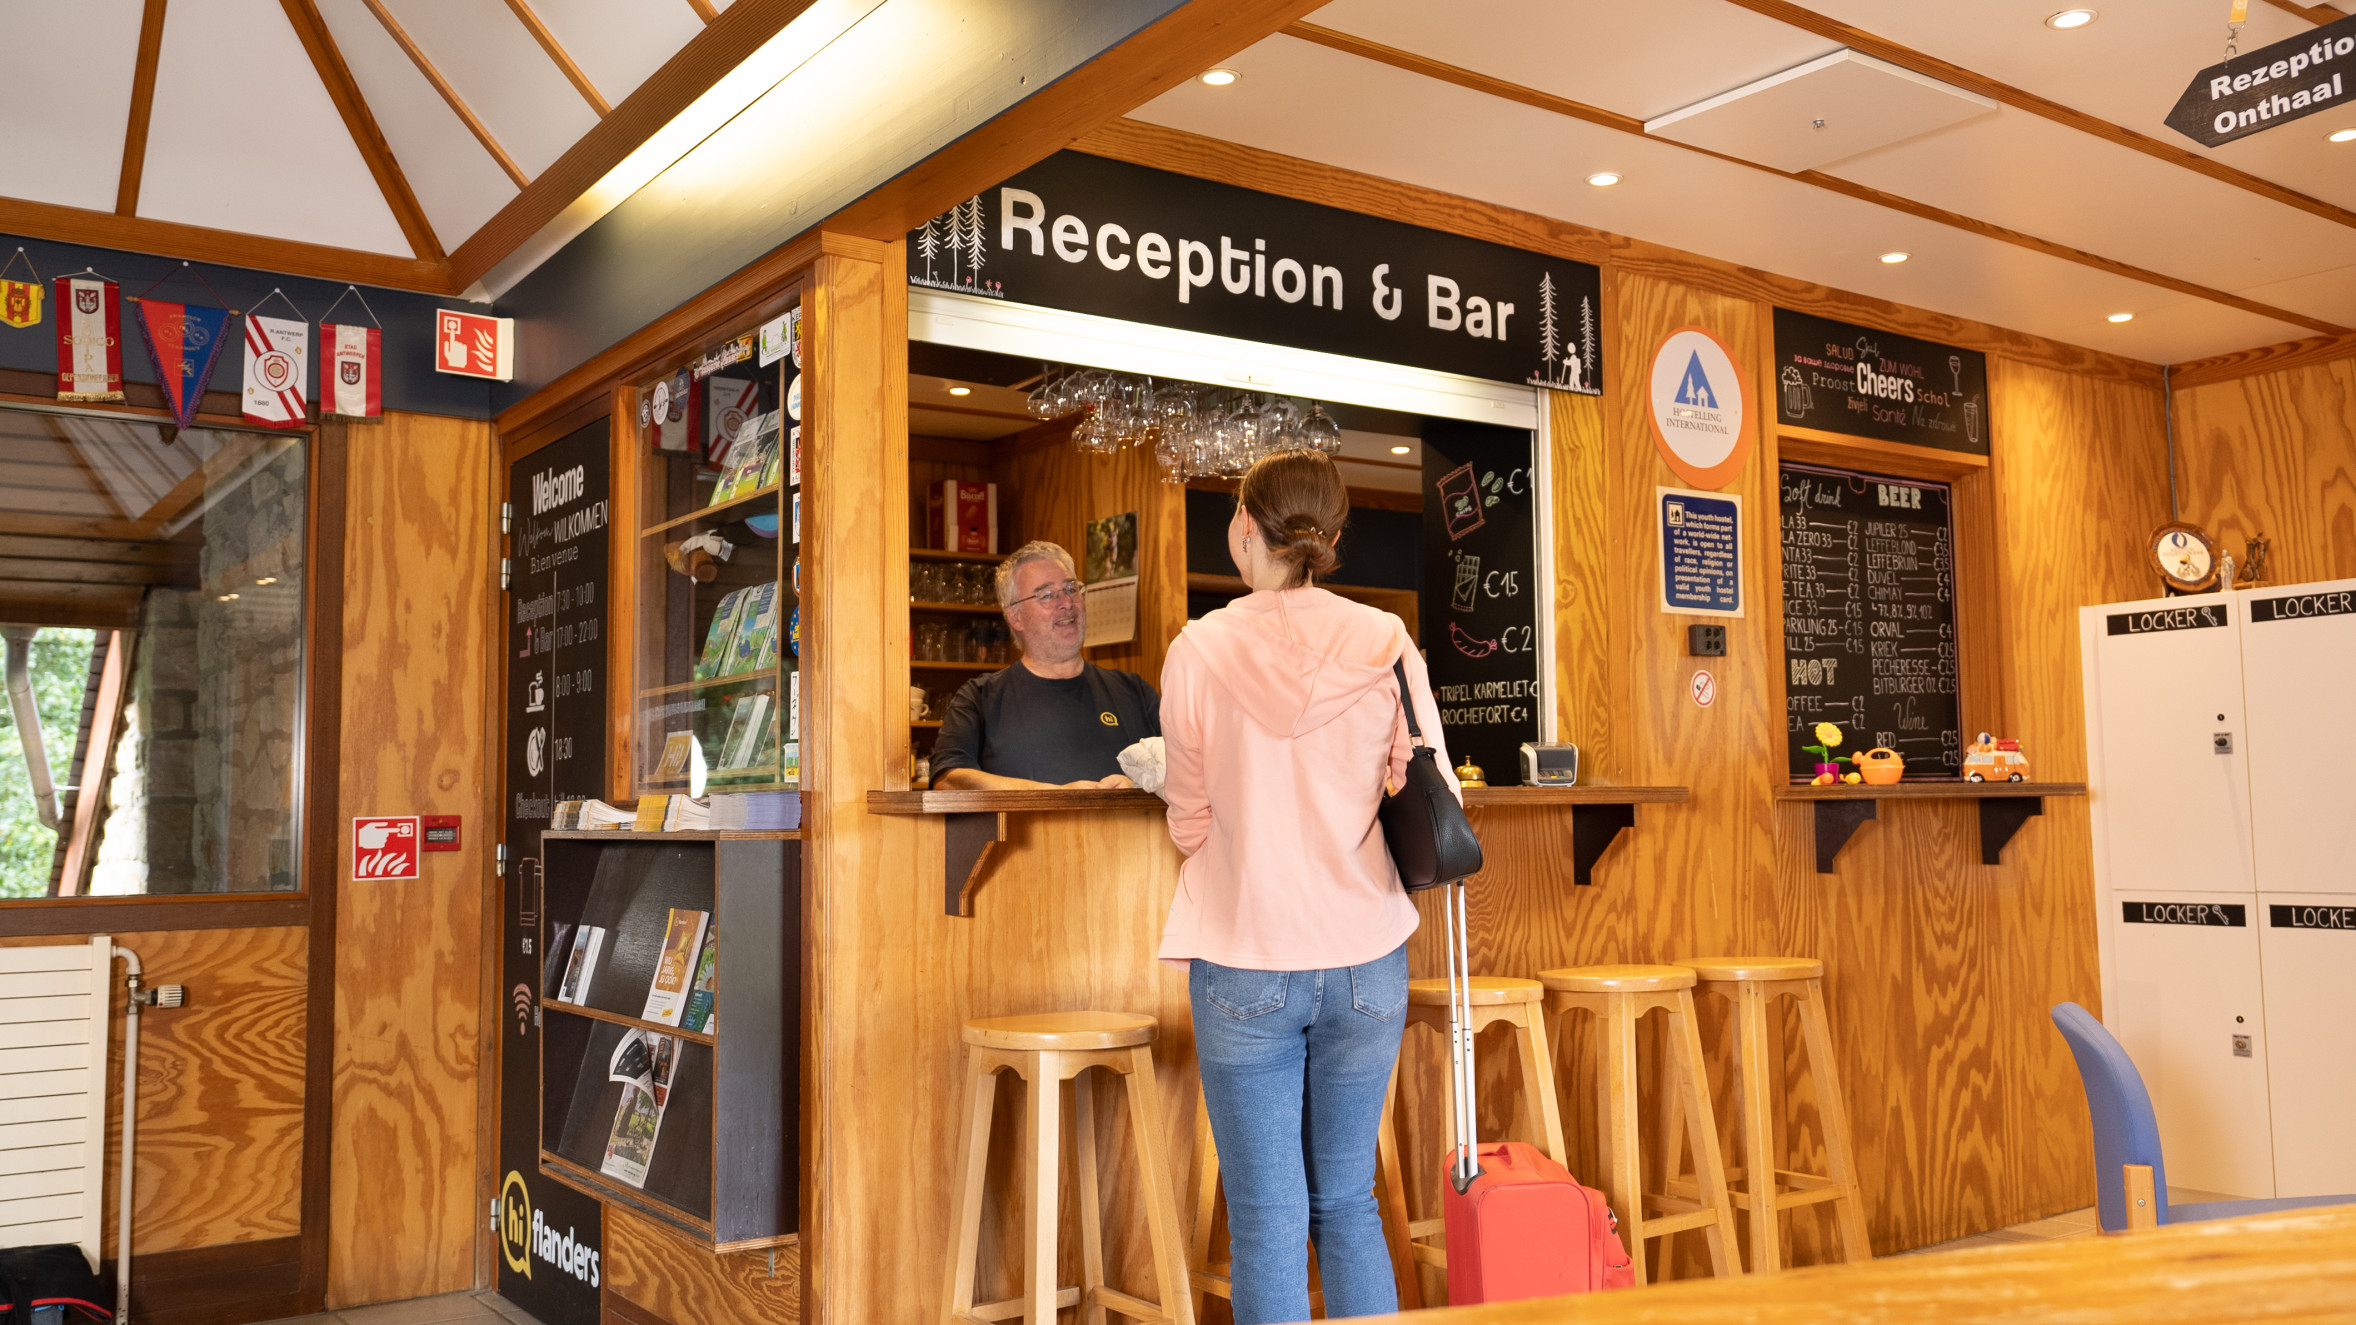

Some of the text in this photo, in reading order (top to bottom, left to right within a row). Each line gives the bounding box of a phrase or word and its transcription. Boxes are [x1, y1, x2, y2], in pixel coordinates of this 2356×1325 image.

[2210, 36, 2356, 100] Rezeptio
[2213, 73, 2343, 134] Onthaal
[1001, 187, 1514, 341] Reception & Bar
[1825, 343, 1854, 360] SALUD
[1880, 358, 1925, 379] ZUM WOHL
[1812, 372, 1857, 393] Proost
[1857, 361, 1914, 403] Cheers
[1917, 388, 1950, 408] Schol
[1872, 405, 1907, 426] Santé
[1666, 418, 1729, 435] INTERNATIONAL
[533, 464, 584, 516] Welcome
[1780, 474, 1842, 515] Soft drink
[1878, 484, 1921, 510] BEER
[1847, 520, 1858, 535] €2
[1936, 527, 1947, 542] €2
[1797, 531, 1820, 546] ZERO
[1821, 533, 1833, 548] 33
[1848, 535, 1859, 550] €2
[530, 545, 579, 574] Bienvenue
[1848, 552, 1859, 567] €2
[1848, 567, 1859, 582] €2
[1867, 569, 1950, 586] DUVEL €4
[1792, 581, 1813, 598] TEA
[1815, 583, 1825, 598] 33
[1847, 583, 1860, 599] €2
[1868, 586, 1950, 602] CHIMAY €4
[517, 592, 553, 628] Reception
[576, 581, 594, 607] 10:00
[1806, 600, 1818, 616] 33
[2272, 592, 2352, 619] LOCKER
[1828, 618, 1838, 635] 25
[1870, 622, 1952, 639] ORVAL €4
[2128, 608, 2197, 632] LOCKER
[540, 626, 553, 653] Bar
[557, 624, 573, 649] 17:00
[579, 618, 598, 643] 22:00
[1501, 626, 1532, 653] €2
[1804, 636, 1815, 652] 25
[1871, 641, 1898, 657] KRIEK
[1791, 658, 1838, 686] HOT
[1872, 659, 1930, 676] PECHERESSE
[556, 669, 592, 698] 8:00 9:00
[1440, 684, 1473, 702] TRIPEL
[1474, 680, 1529, 699] KARMELIET
[1873, 677, 1924, 695] BITBURGER
[1852, 695, 1865, 712] €2
[1893, 696, 1929, 730] Wine
[1442, 705, 1528, 725] ROCHEFORT €4
[1852, 713, 1866, 730] €2
[554, 737, 573, 761] 18:30
[1876, 732, 1896, 748] RED
[515, 792, 550, 819] Checkout
[2142, 903, 2209, 925] LOCKER
[508, 1196, 524, 1246] hi
[532, 1208, 600, 1288] flanders
